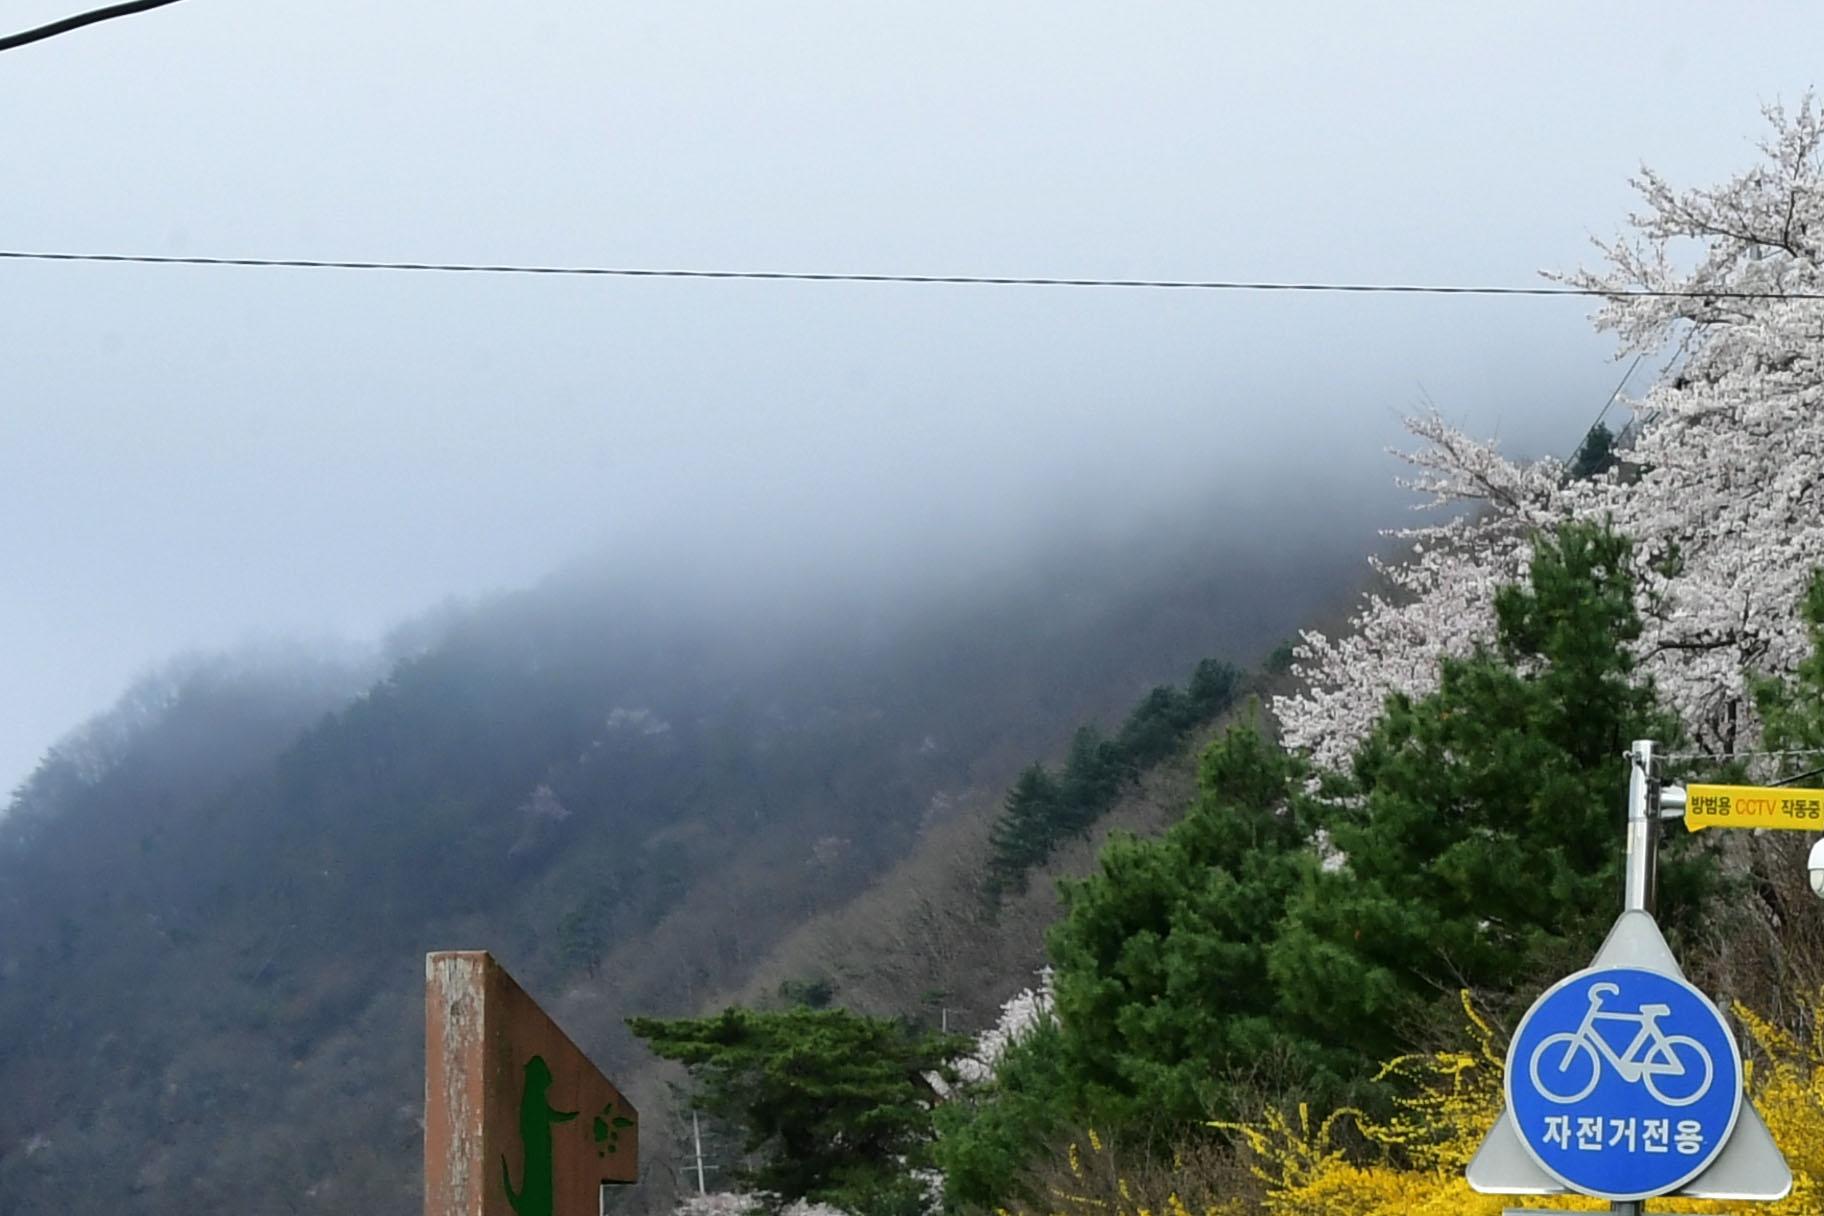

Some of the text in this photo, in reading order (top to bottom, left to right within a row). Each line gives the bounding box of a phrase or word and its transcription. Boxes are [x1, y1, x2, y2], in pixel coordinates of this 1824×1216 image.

[1691, 796, 1821, 819] 방범용 CCTV 작동중
[1542, 1115, 1704, 1155] 자전거전용
